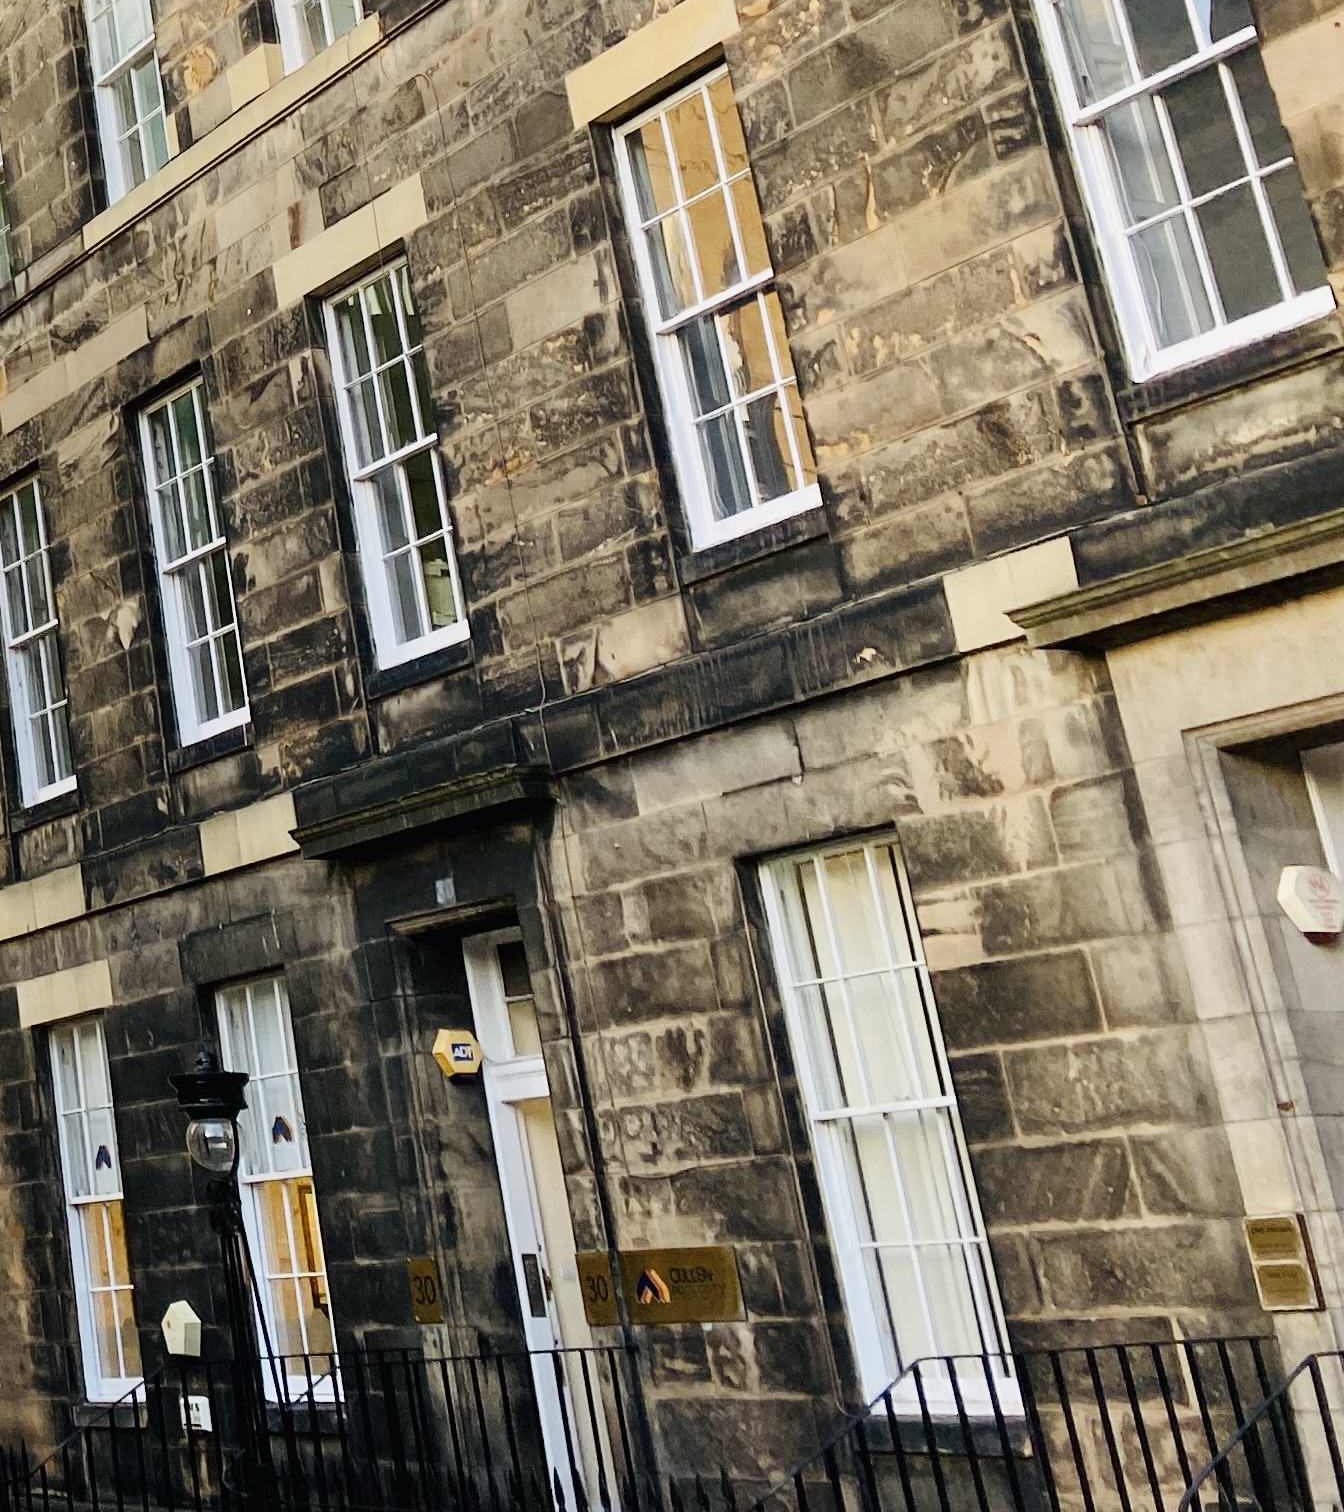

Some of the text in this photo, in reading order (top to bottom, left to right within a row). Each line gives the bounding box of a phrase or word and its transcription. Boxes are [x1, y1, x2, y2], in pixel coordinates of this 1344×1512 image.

[453, 1045, 473, 1059] ADT
[413, 1275, 438, 1305] 30
[585, 1275, 609, 1304] 30
